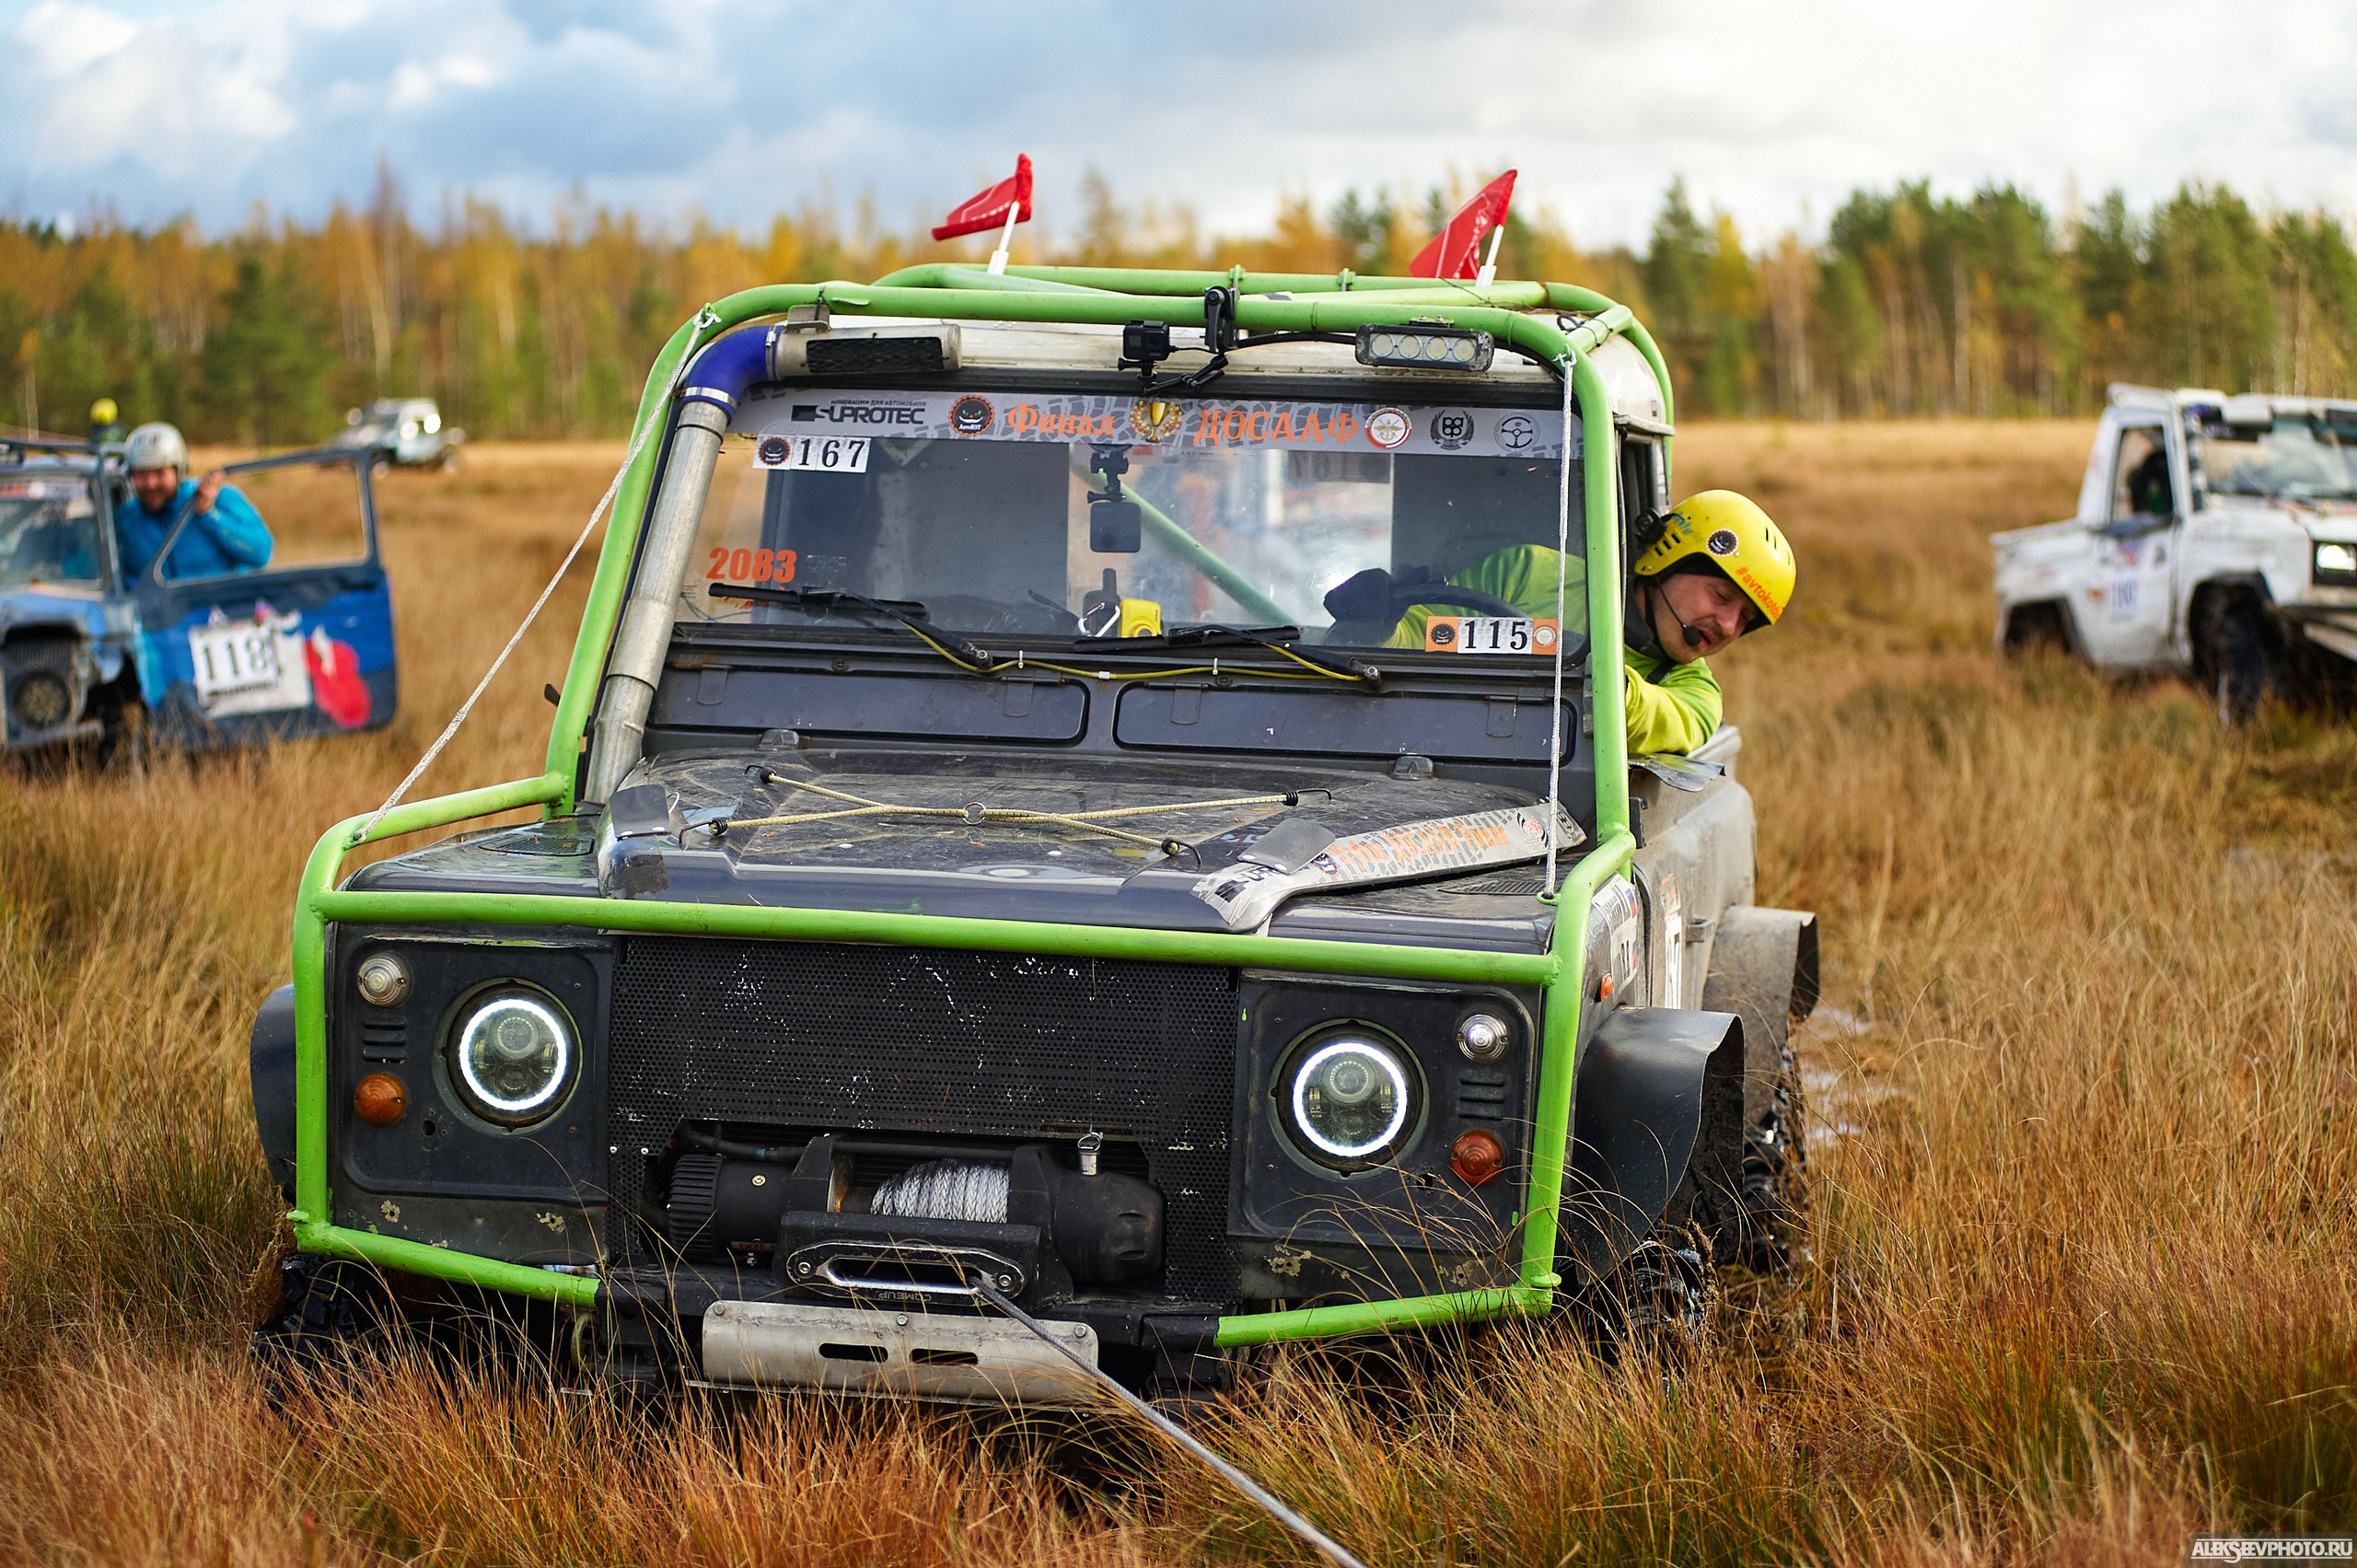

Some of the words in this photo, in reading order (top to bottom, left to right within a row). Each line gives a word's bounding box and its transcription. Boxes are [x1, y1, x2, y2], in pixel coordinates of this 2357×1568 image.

[814, 405, 925, 424] SUPROTEC
[1007, 403, 1116, 436] Финал
[1192, 410, 1358, 446] ДОСААФ
[798, 438, 865, 468] 167
[706, 547, 797, 583] 2083
[1465, 620, 1528, 650] 115
[878, 1291, 932, 1302] COMEUP
